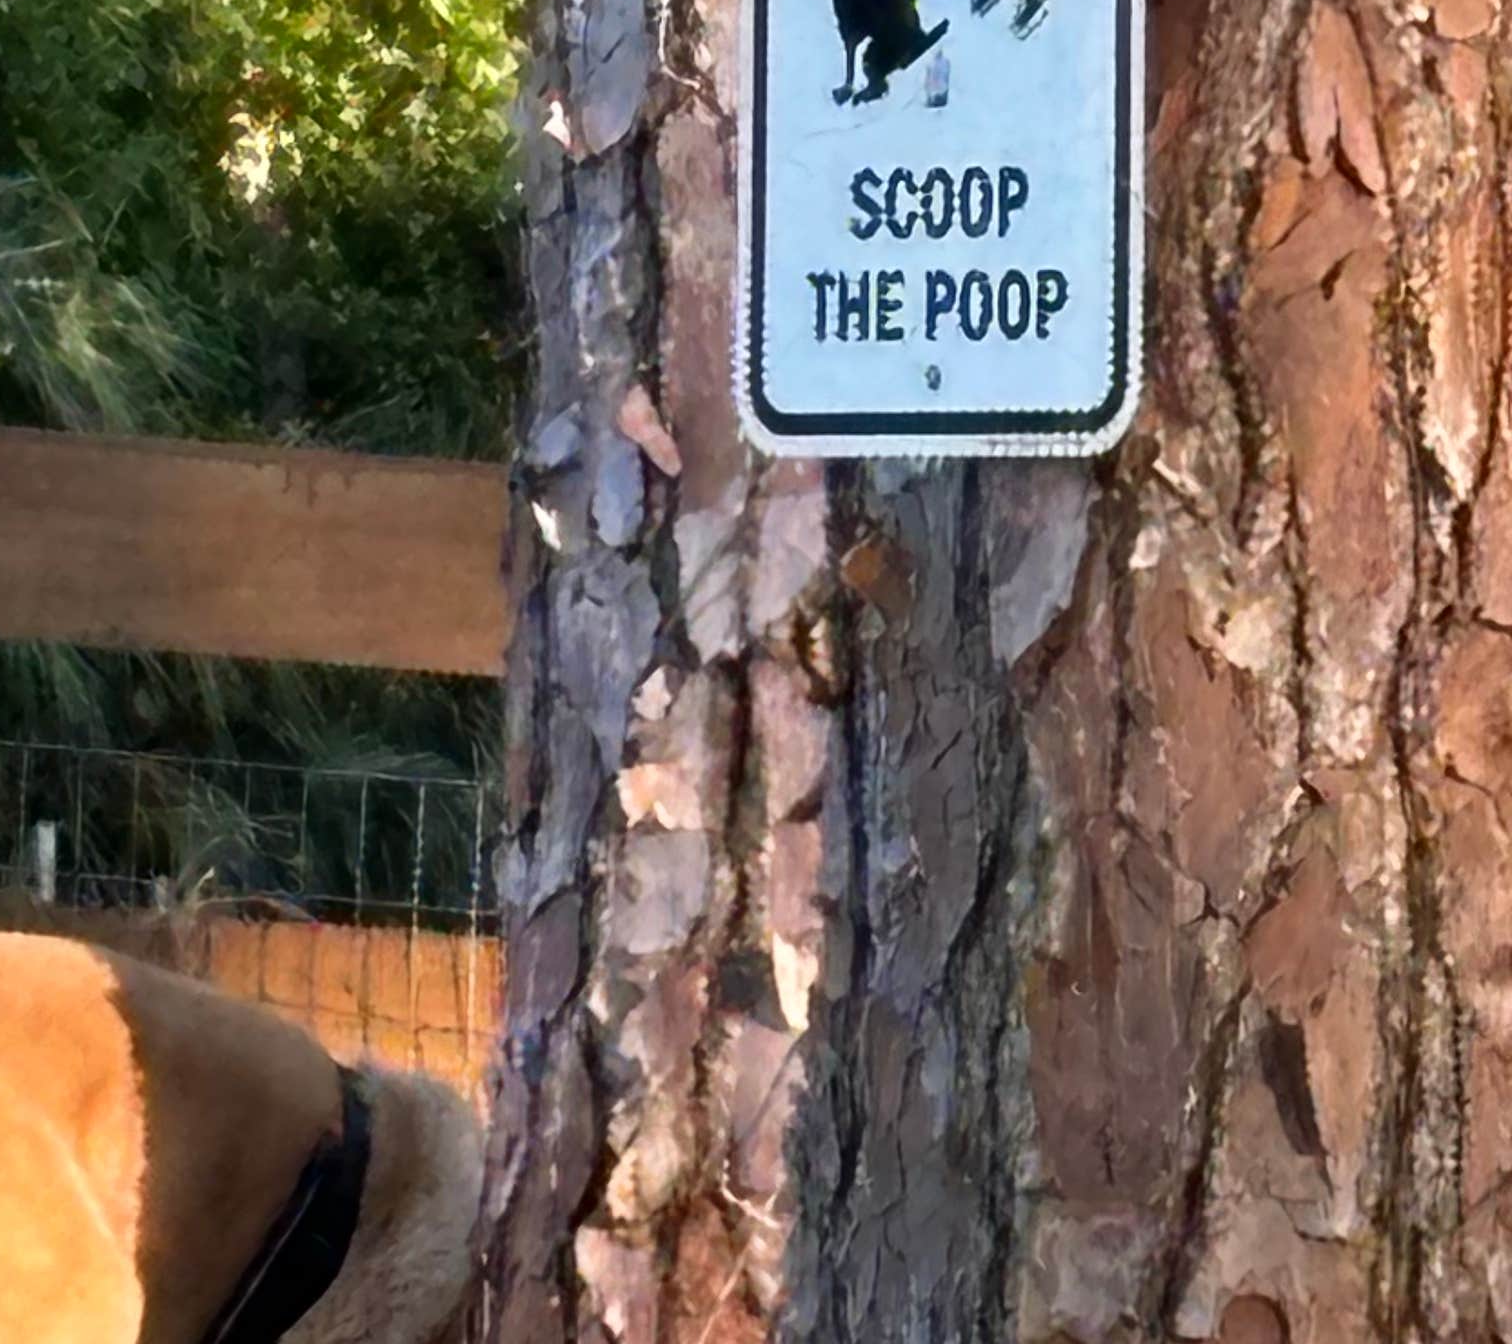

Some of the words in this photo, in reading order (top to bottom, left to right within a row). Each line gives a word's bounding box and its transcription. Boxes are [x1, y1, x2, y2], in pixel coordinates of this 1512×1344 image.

[848, 166, 1029, 240] SCOOP
[806, 269, 905, 342] THE
[925, 269, 1069, 341] POOP
